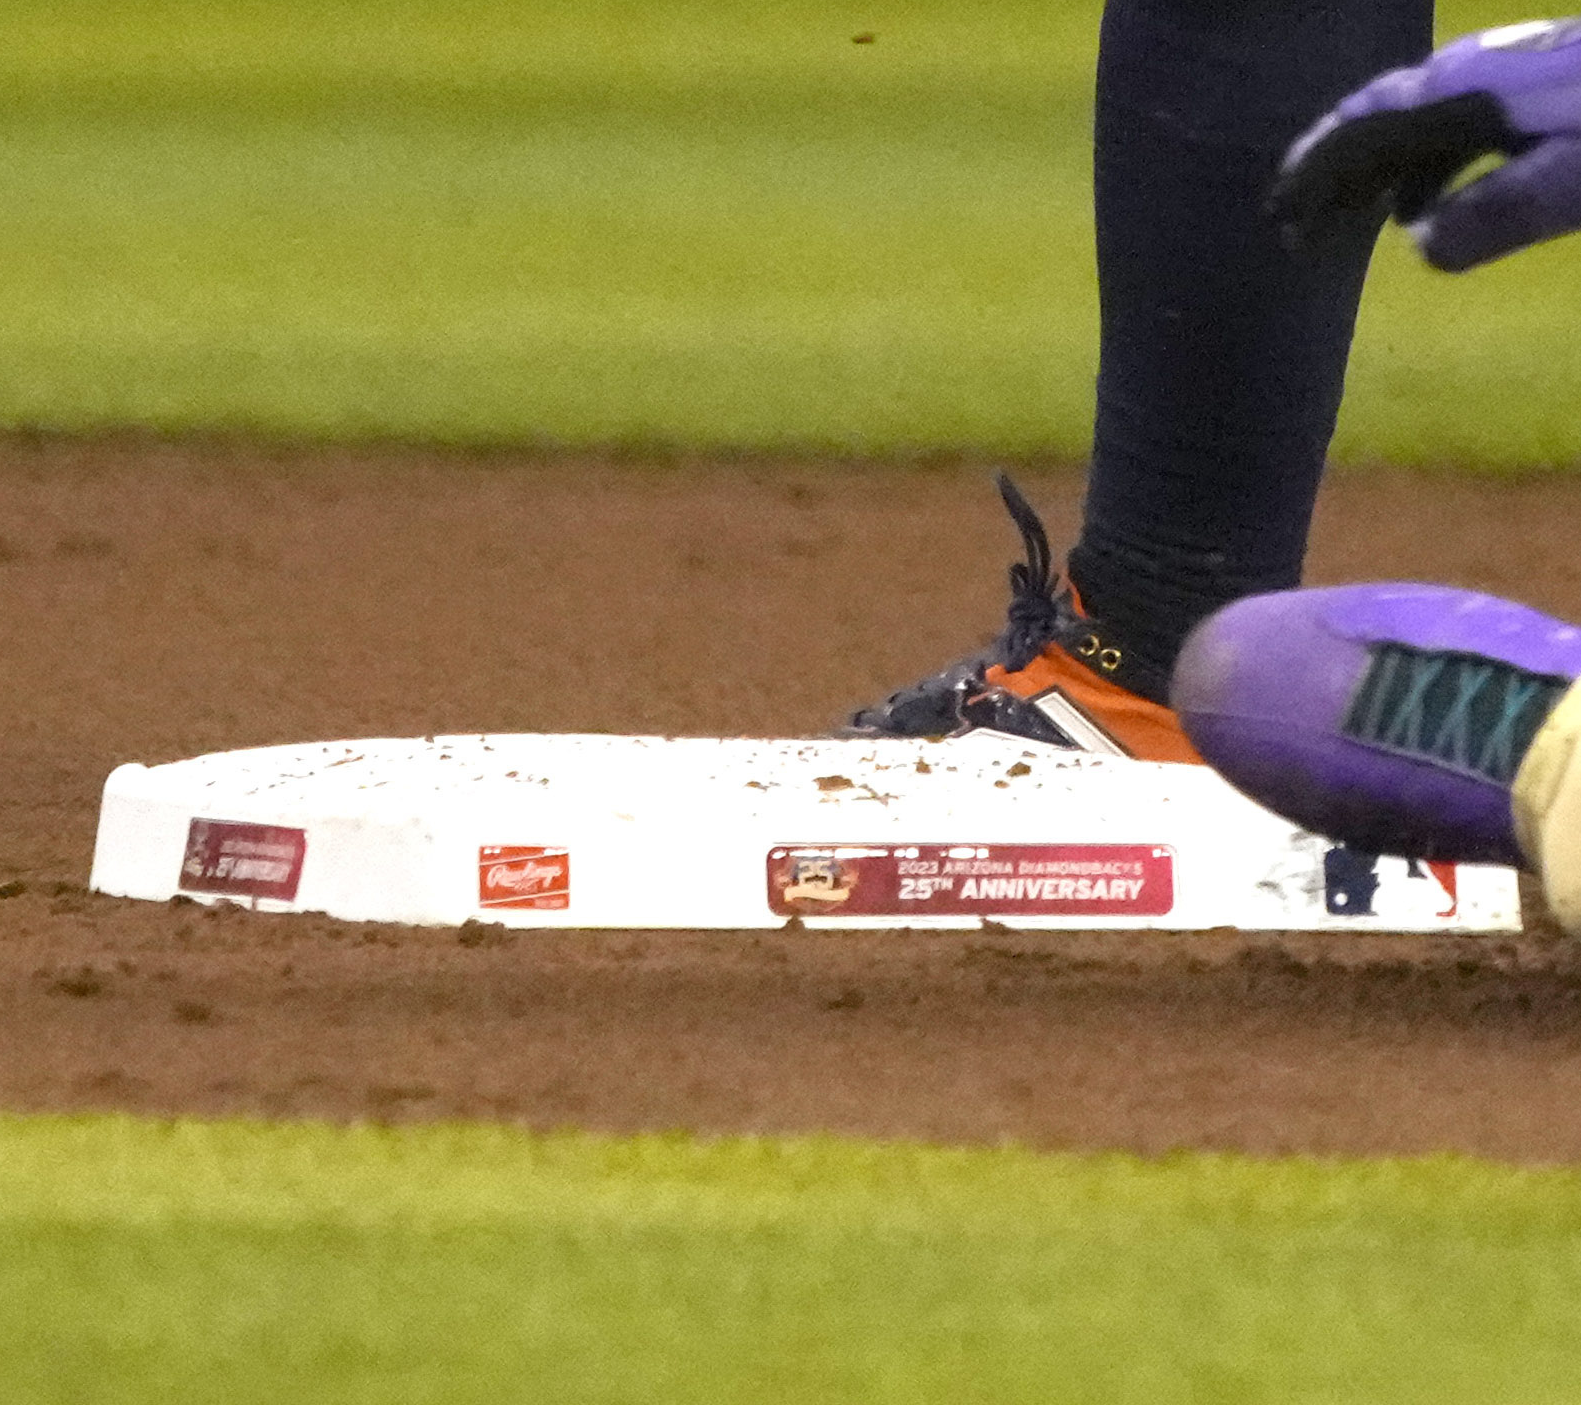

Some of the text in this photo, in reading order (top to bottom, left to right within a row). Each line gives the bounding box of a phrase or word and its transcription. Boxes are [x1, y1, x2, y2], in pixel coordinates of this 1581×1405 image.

[897, 861, 1143, 876] 2023 ARIZONA DIAMONDBACKS
[898, 876, 1146, 901] 25TH ANNIVERSARY
